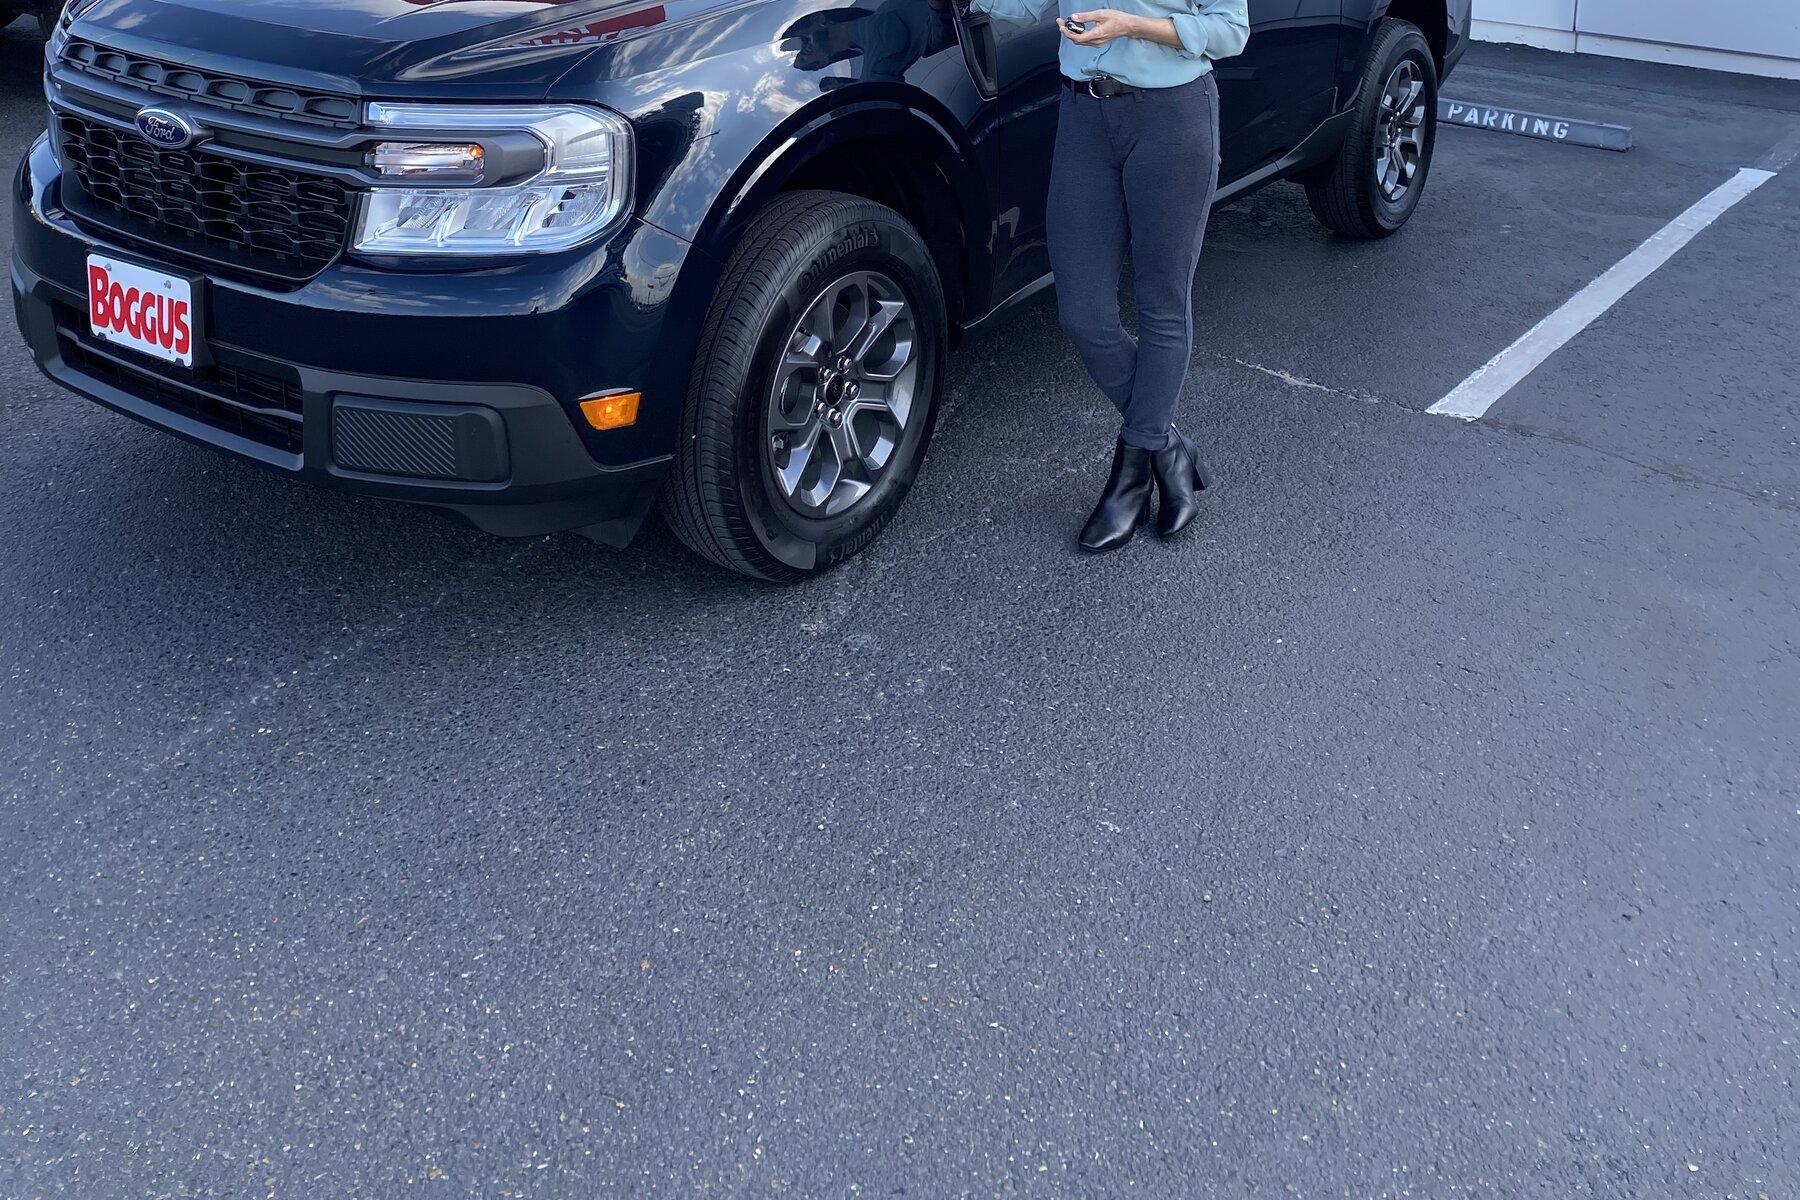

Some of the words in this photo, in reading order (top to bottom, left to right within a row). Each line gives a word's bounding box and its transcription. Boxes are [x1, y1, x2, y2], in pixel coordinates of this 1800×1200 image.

[145, 116, 176, 140] Ford
[1447, 103, 1570, 139] PARKING
[89, 264, 190, 355] BOGGUS
